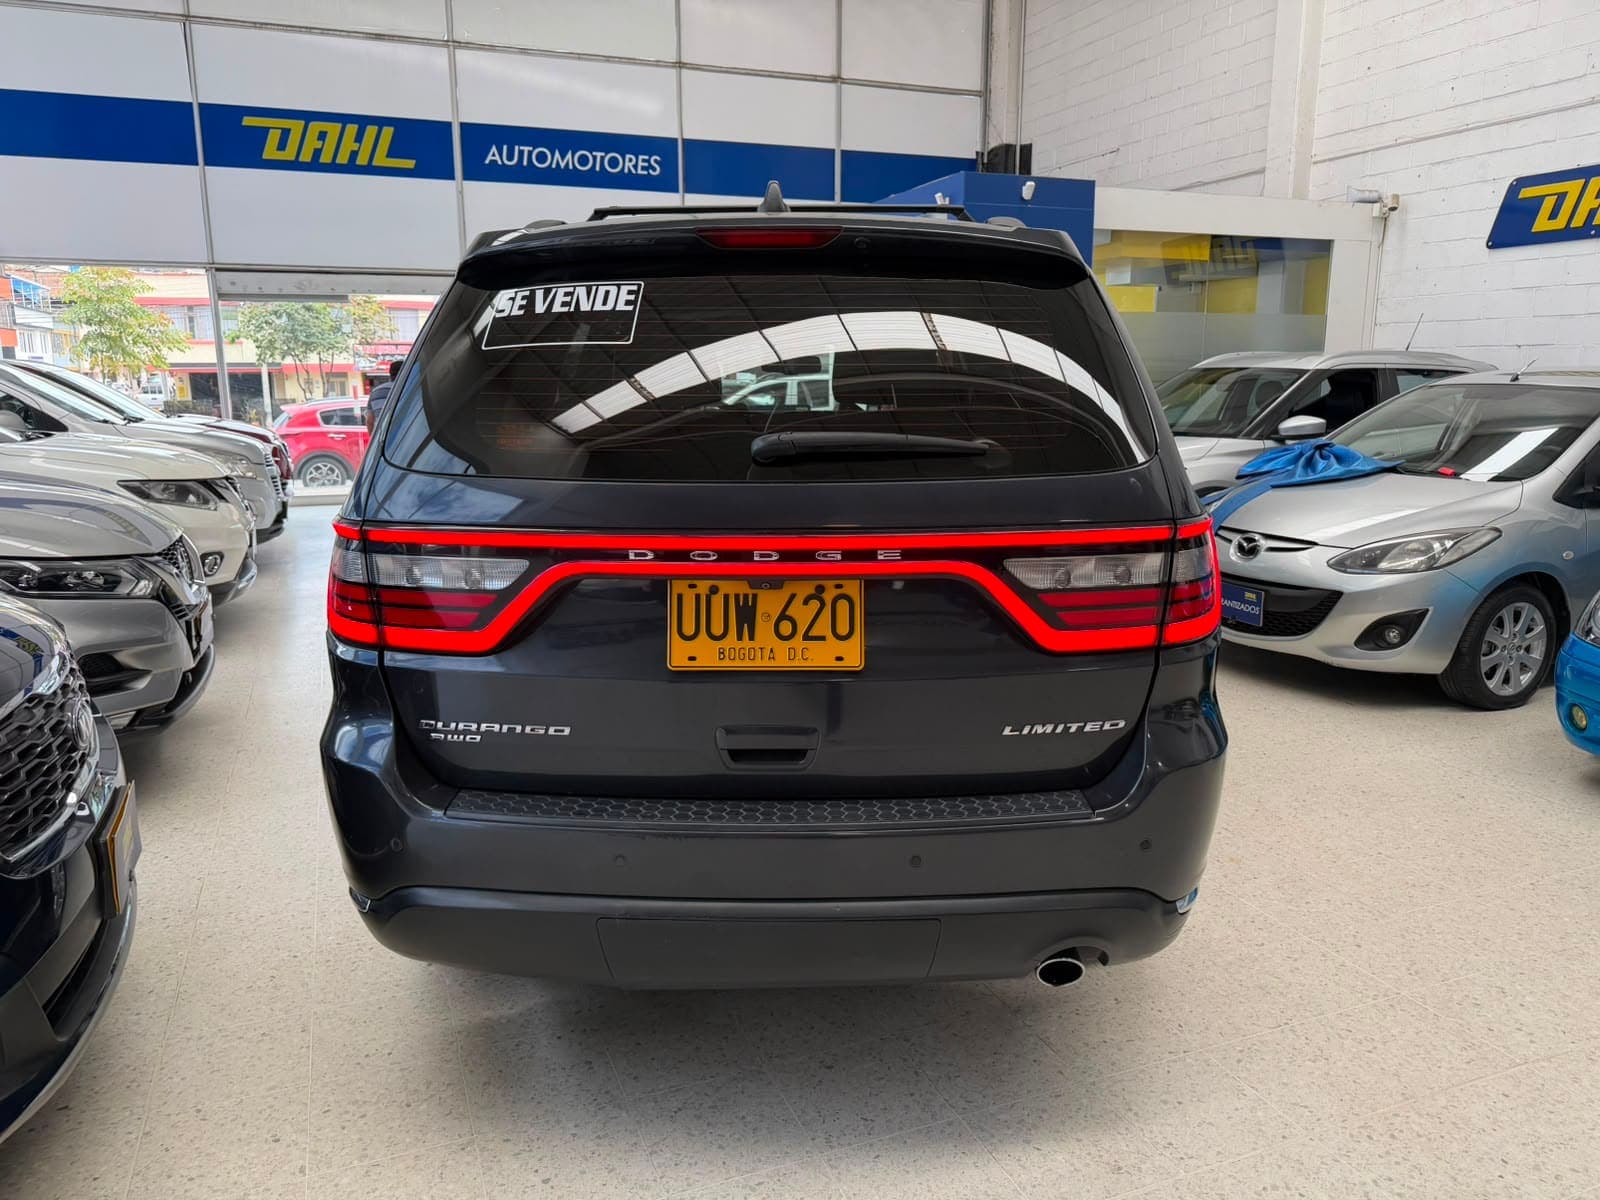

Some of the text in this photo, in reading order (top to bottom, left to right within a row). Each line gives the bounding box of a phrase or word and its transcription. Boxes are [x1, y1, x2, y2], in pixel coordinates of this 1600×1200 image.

[241, 116, 662, 176] DAHL AUTOMOTORES
[495, 285, 638, 318] SE VENDE
[628, 549, 902, 561] DODGE
[676, 593, 855, 642] UUW 620
[718, 647, 814, 661] BOGOTA D.C.
[419, 719, 571, 736] DURANGO
[1002, 719, 1127, 736] LIMITED
